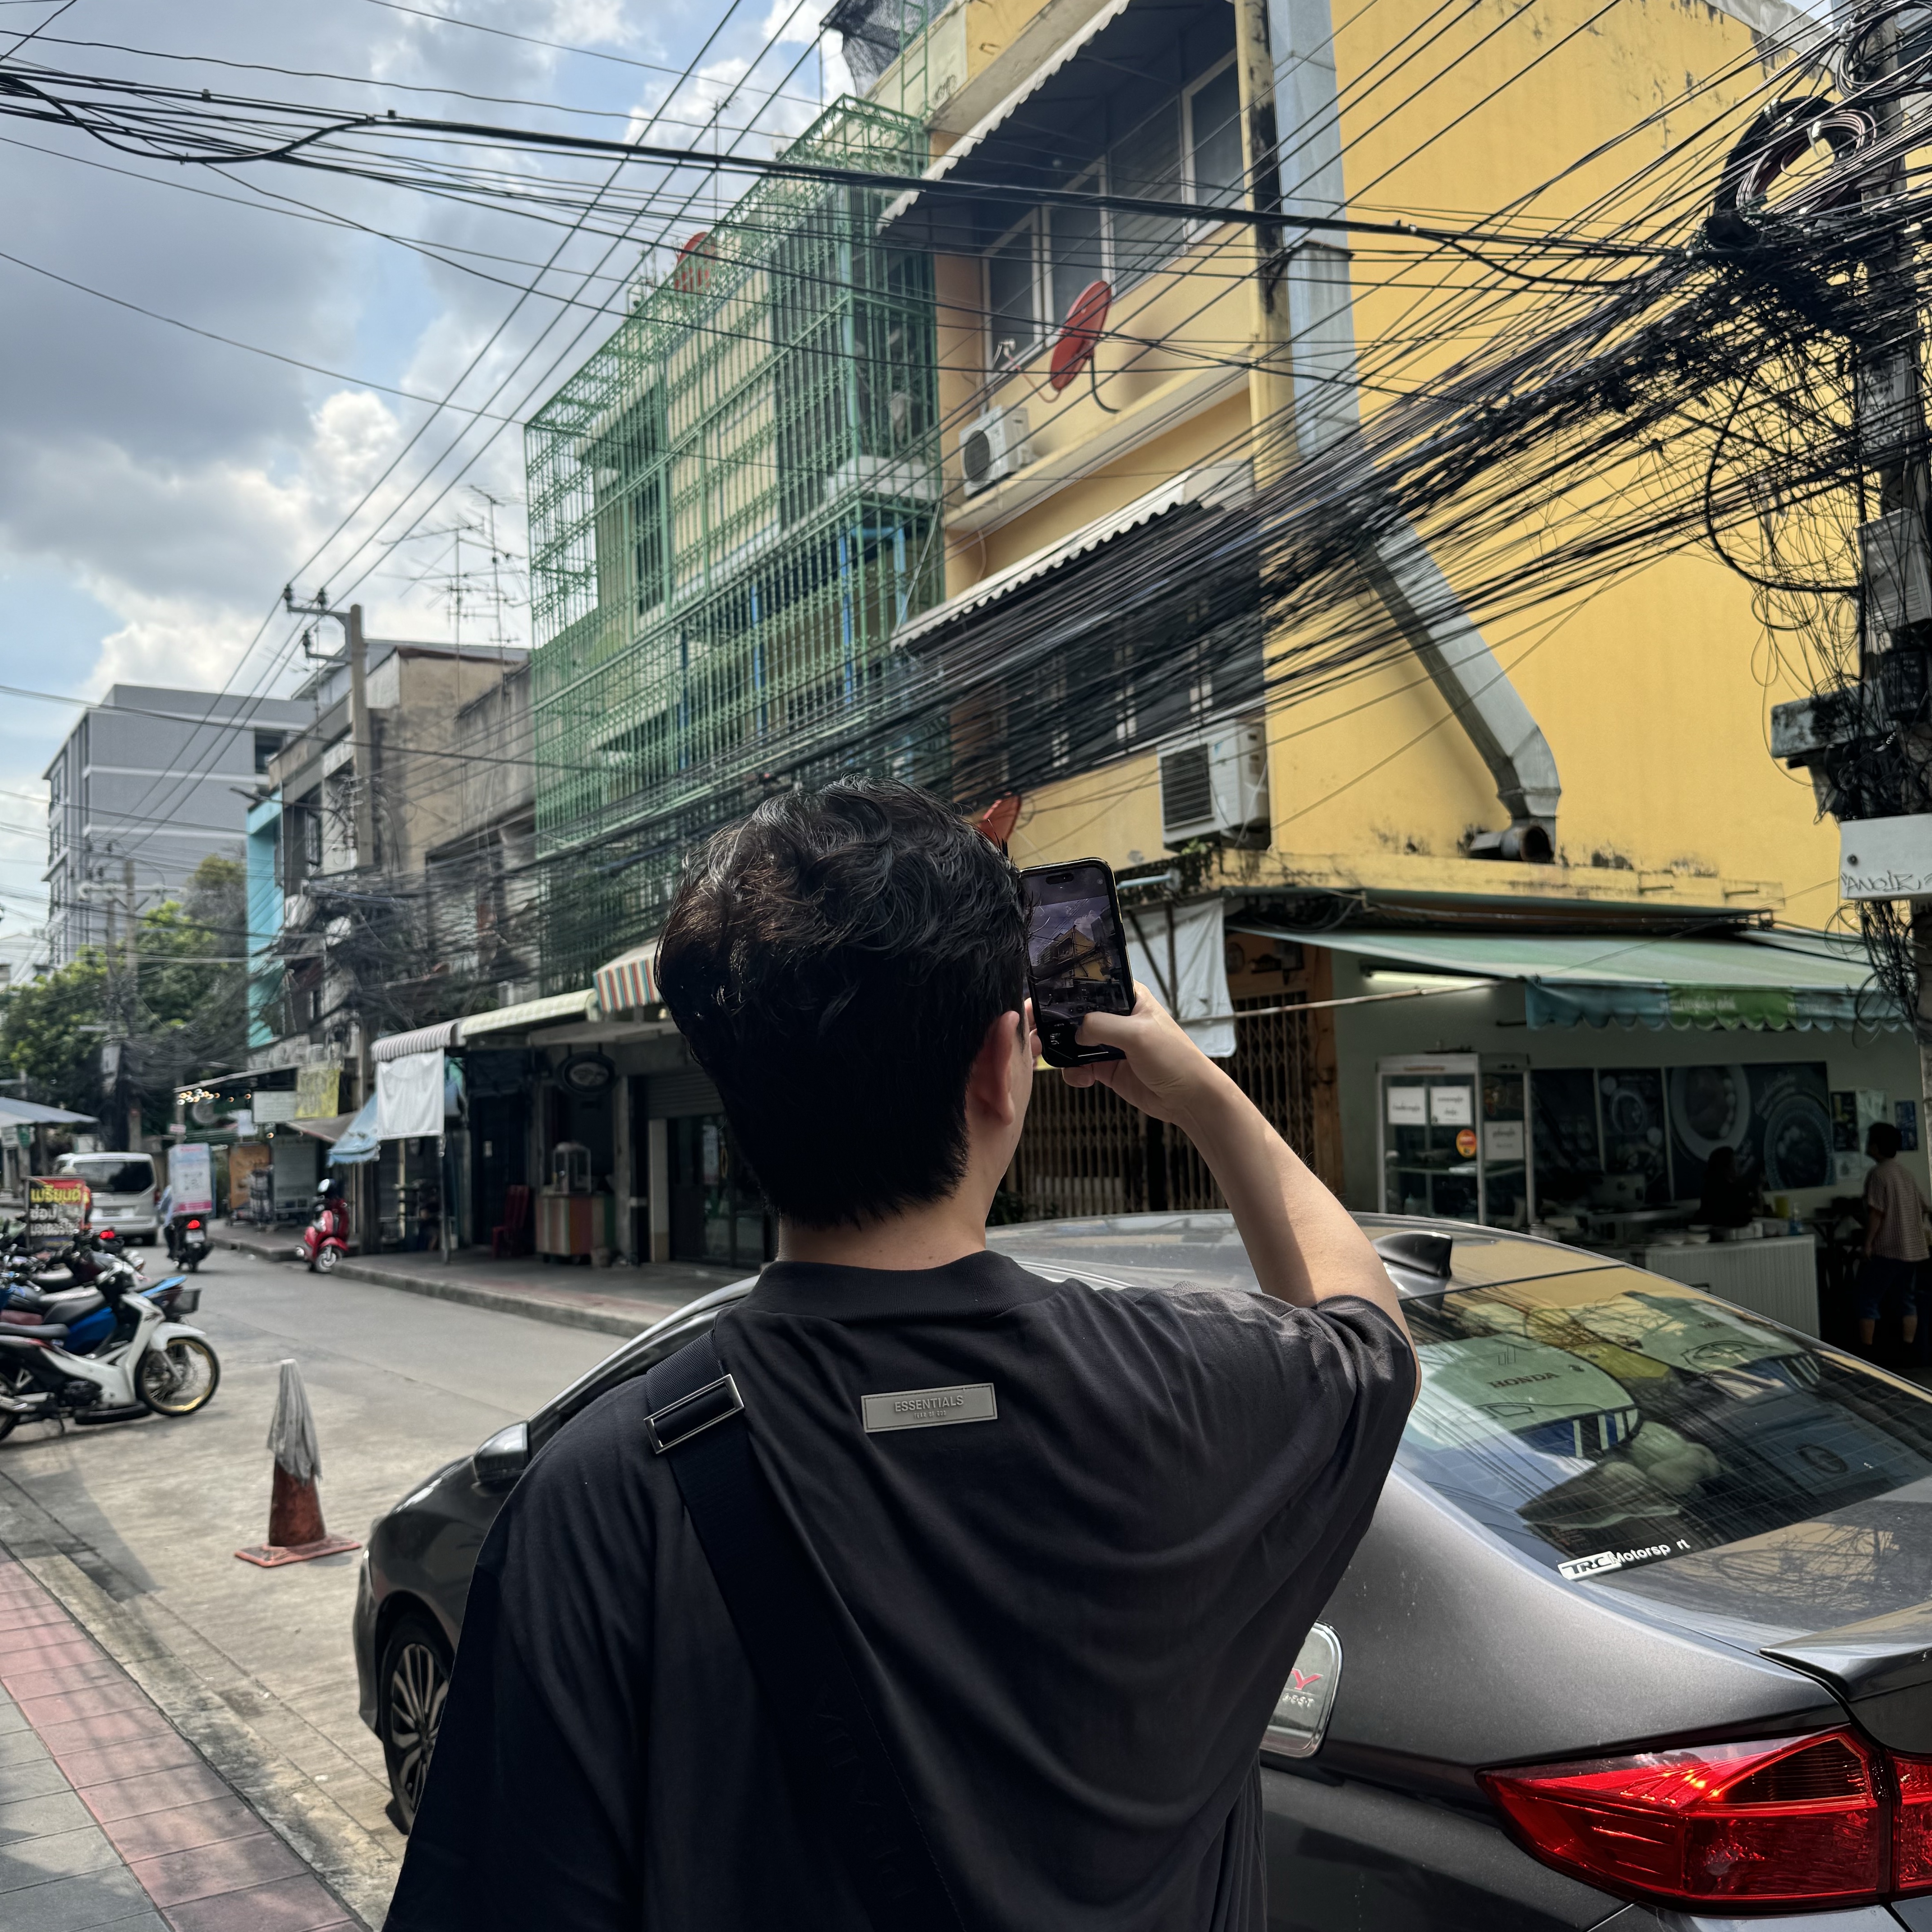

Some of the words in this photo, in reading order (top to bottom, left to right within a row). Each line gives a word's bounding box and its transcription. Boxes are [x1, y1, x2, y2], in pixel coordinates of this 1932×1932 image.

[1487, 1372, 1560, 1388] HONDA
[894, 1395, 964, 1412] ESSENTIALS
[1608, 1539, 1691, 1564] Motorsprt
